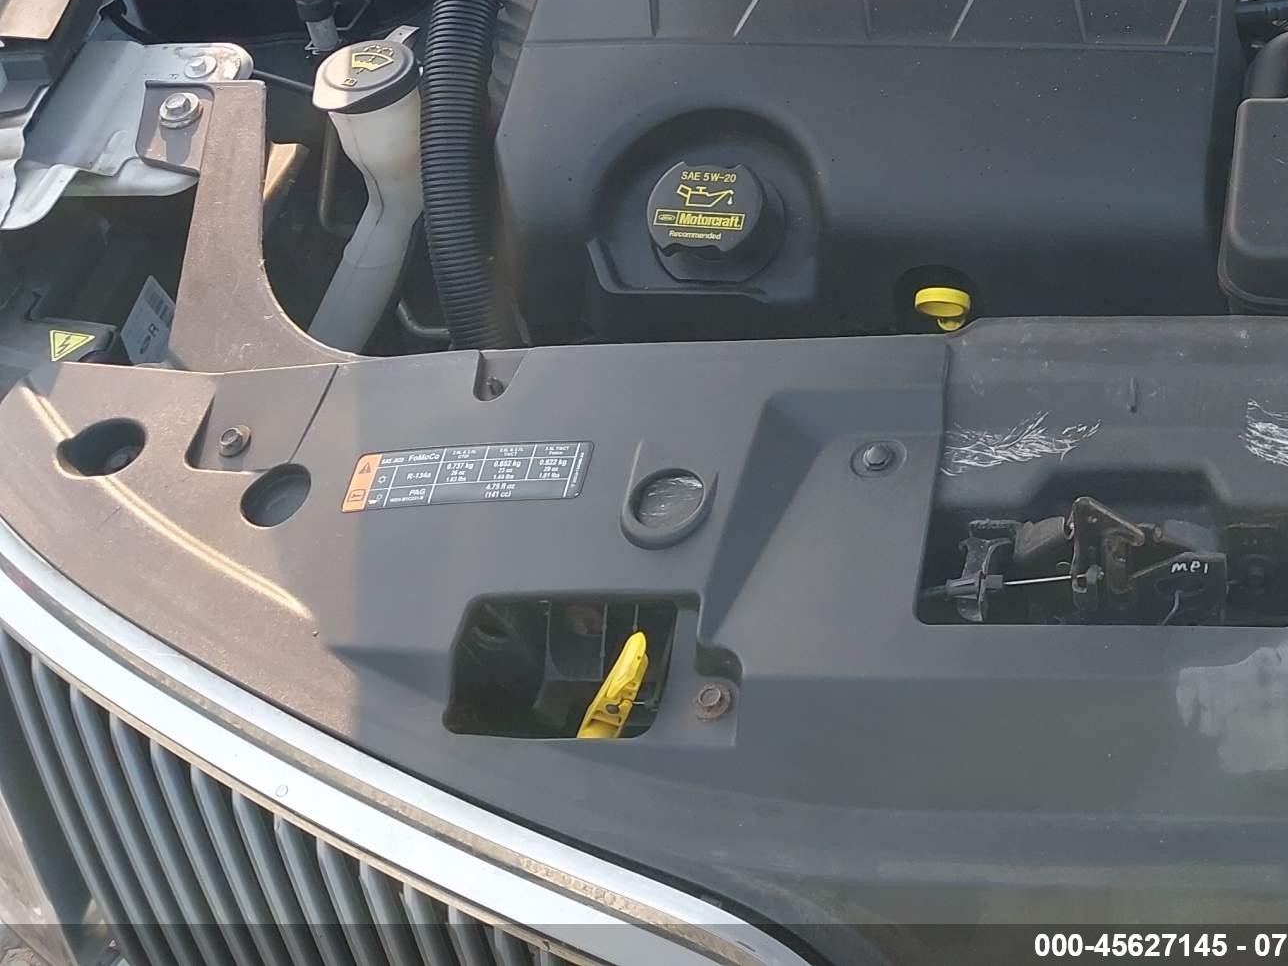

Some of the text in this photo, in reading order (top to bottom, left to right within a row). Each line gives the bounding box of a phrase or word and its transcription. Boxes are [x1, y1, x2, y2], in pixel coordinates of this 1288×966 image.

[681, 171, 737, 183] SAE 5W-20
[679, 213, 740, 227] Motorcraft
[668, 229, 722, 240] Recommended
[408, 453, 440, 462] FoMoCo
[406, 472, 432, 480] R-134a
[408, 488, 427, 496] PAG
